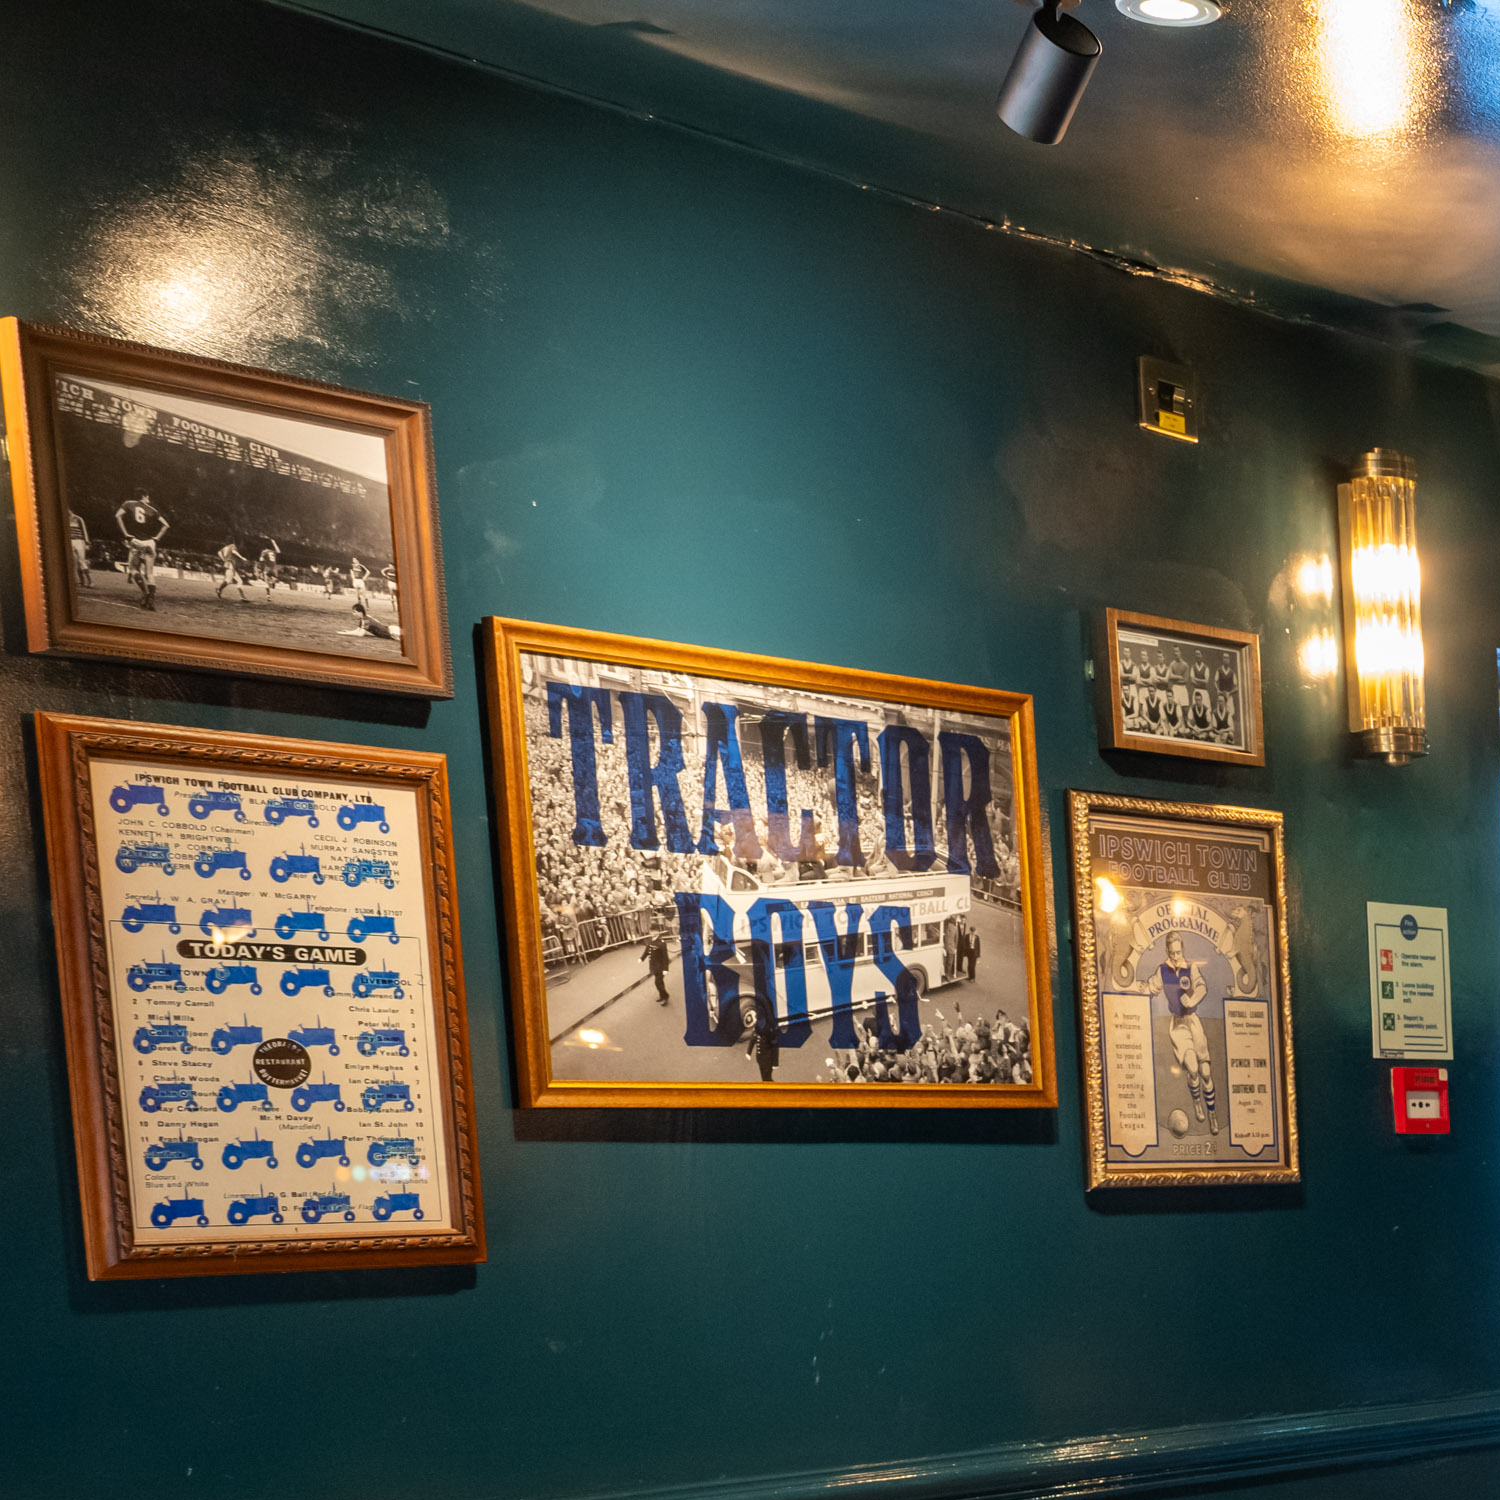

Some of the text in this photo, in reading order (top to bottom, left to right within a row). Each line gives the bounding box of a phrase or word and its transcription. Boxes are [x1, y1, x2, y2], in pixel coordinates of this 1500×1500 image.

[56, 379, 279, 458] ICH TOWN FOOTBALL CLUB
[135, 506, 146, 523] 6
[547, 682, 1000, 879] TRACTOR
[135, 773, 180, 785] IPSWICH
[184, 778, 213, 789] TOWN
[217, 781, 268, 794] FOOTBALL
[272, 786, 299, 797] CLUB
[301, 790, 352, 802] COMPANY,
[249, 799, 337, 812] BLANCHE COBBOLD
[118, 818, 255, 836] JOHN COBBOLD (Chairman)
[118, 829, 162, 838] KENNETH
[314, 834, 397, 847] CECIL ROBINSON
[187, 844, 232, 853] COBBOLD
[310, 844, 398, 857] MURRAY SANGSTER
[1100, 834, 1257, 872] IPSWICH TOWN
[120, 850, 213, 861] PATRICK COBBOLD
[321, 865, 400, 876] HAROLD SMITH
[1109, 860, 1251, 891] FOOTBALL CLUB
[200, 897, 227, 905] GRAY
[274, 892, 317, 900] McGARRY
[826, 907, 876, 924] TOWN
[881, 901, 948, 920] FOOTBALL
[1148, 917, 1220, 943] PROGRAMME
[189, 942, 357, 963] TODAY'S GAME
[676, 892, 922, 1050] BOYS
[360, 978, 412, 986] LIVERPOOL
[146, 999, 182, 1007] Tommy
[1403, 1014, 1418, 1022] Report
[1404, 1022, 1425, 1030] assembly
[181, 1060, 213, 1068] Stacey
[255, 1058, 305, 1066] RESTAURANT
[344, 1064, 370, 1072] Emlyn
[258, 1068, 310, 1086] BUTTERMARKET
[1117, 1084, 1145, 1092] opening
[287, 1115, 314, 1123] Davey
[1173, 1145, 1201, 1155] PRICE
